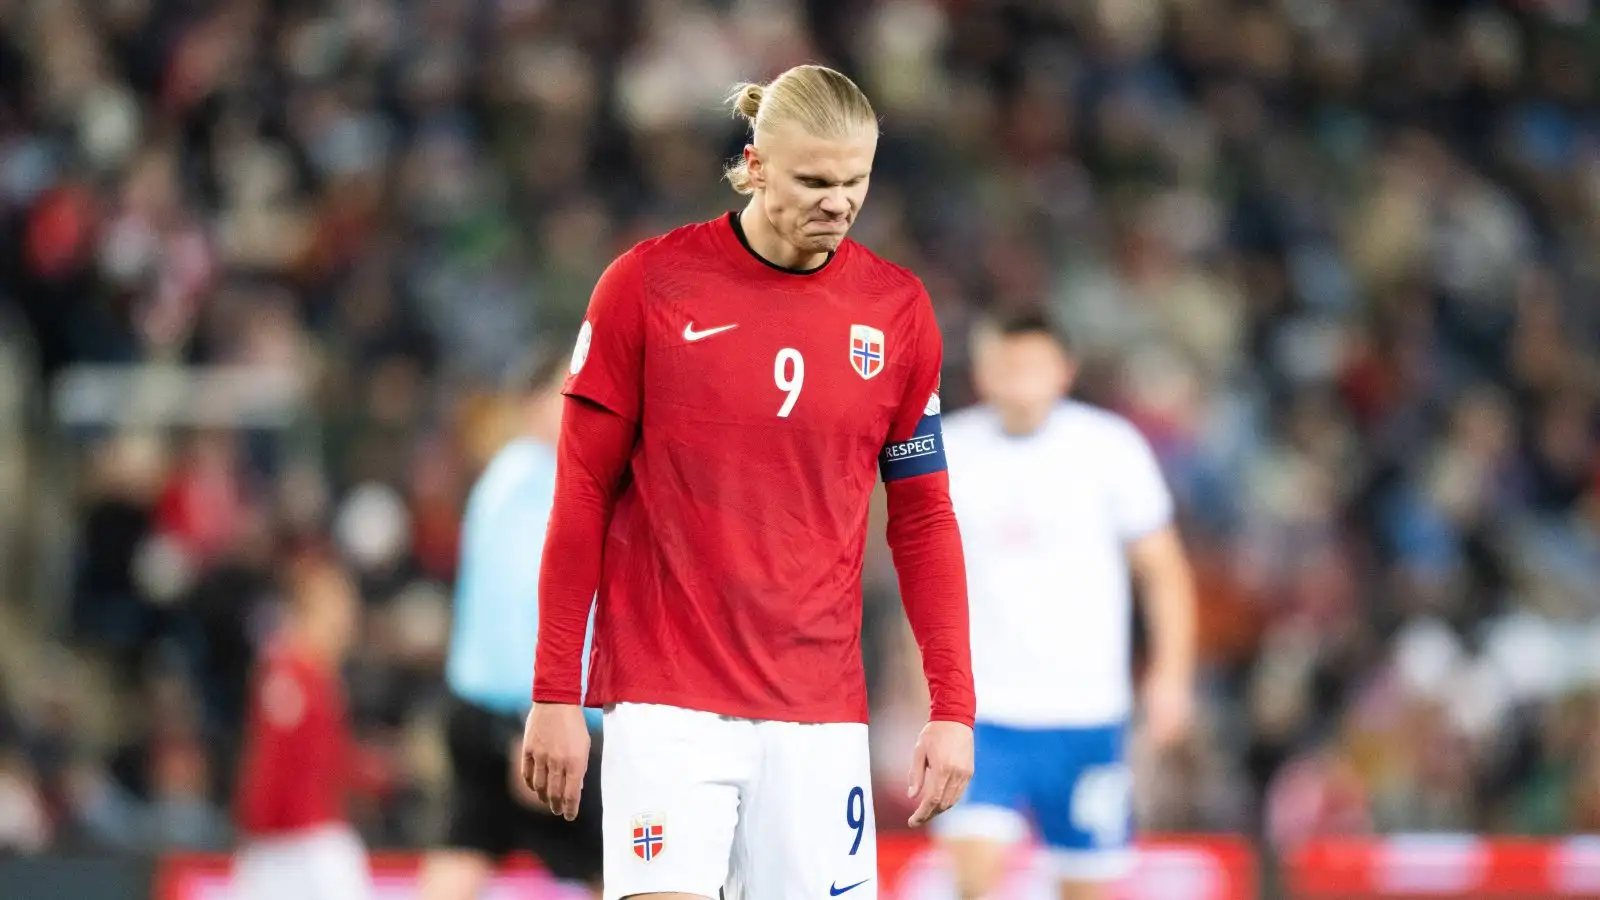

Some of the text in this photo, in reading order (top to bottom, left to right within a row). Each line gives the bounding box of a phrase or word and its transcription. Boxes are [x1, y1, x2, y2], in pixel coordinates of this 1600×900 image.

[774, 347, 805, 418] 9
[885, 438, 935, 458] RESPECT
[846, 786, 865, 855] 9
